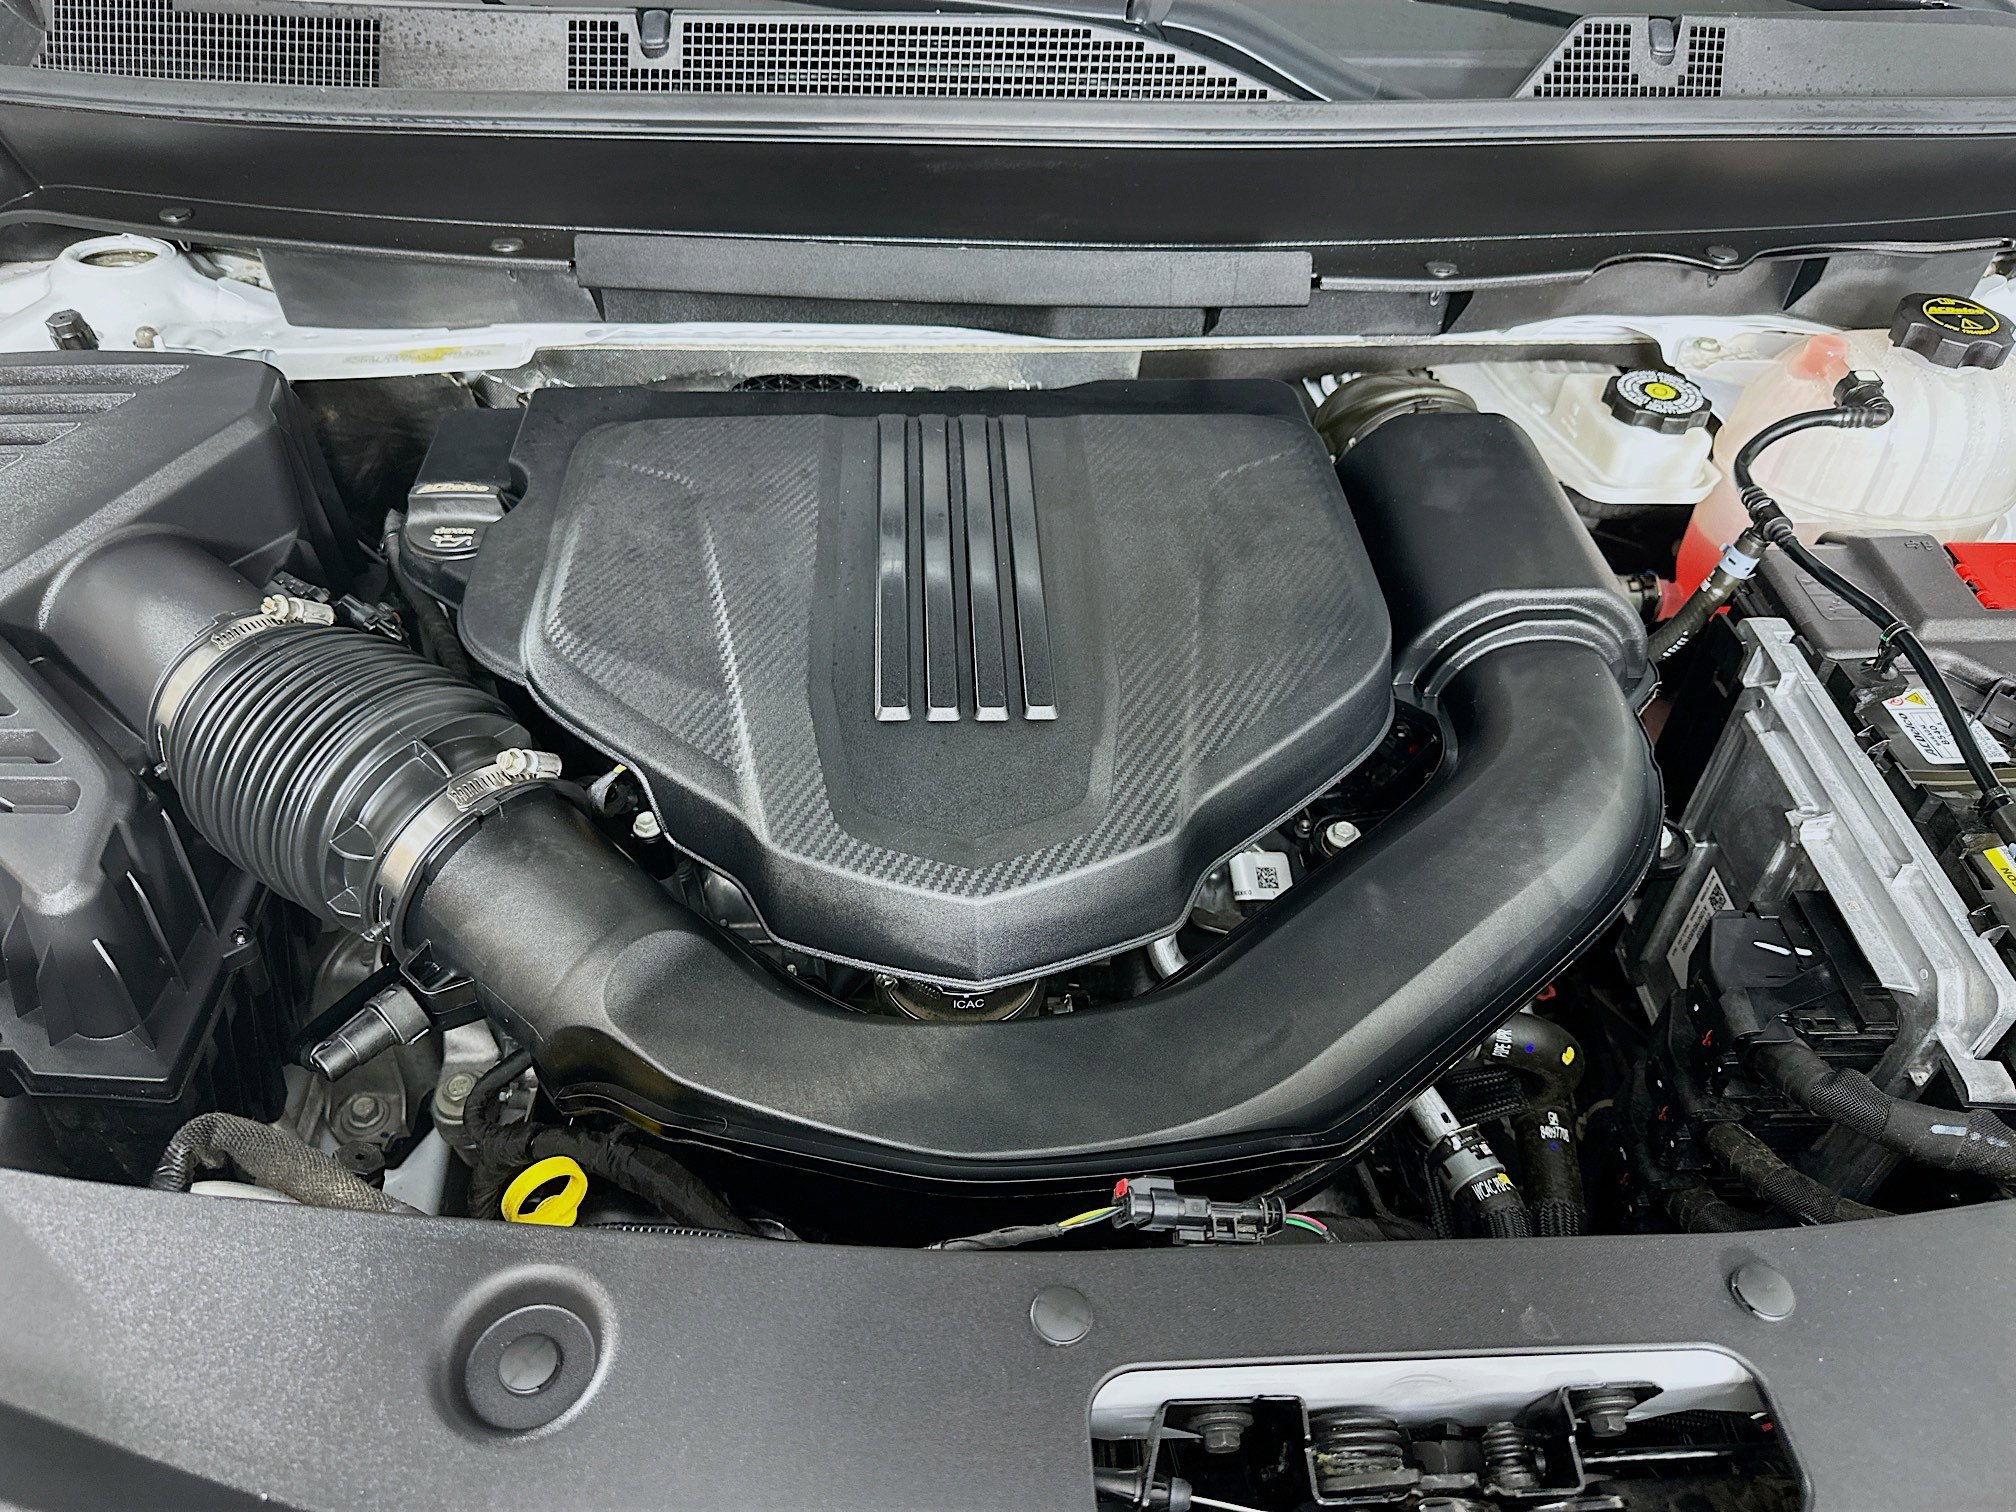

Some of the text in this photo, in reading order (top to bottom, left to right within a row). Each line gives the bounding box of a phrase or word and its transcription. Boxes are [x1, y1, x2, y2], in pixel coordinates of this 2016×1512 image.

[434, 526, 477, 535] dexos
[1898, 712, 1938, 757] ACDelco
[953, 999, 985, 1010] ICAC
